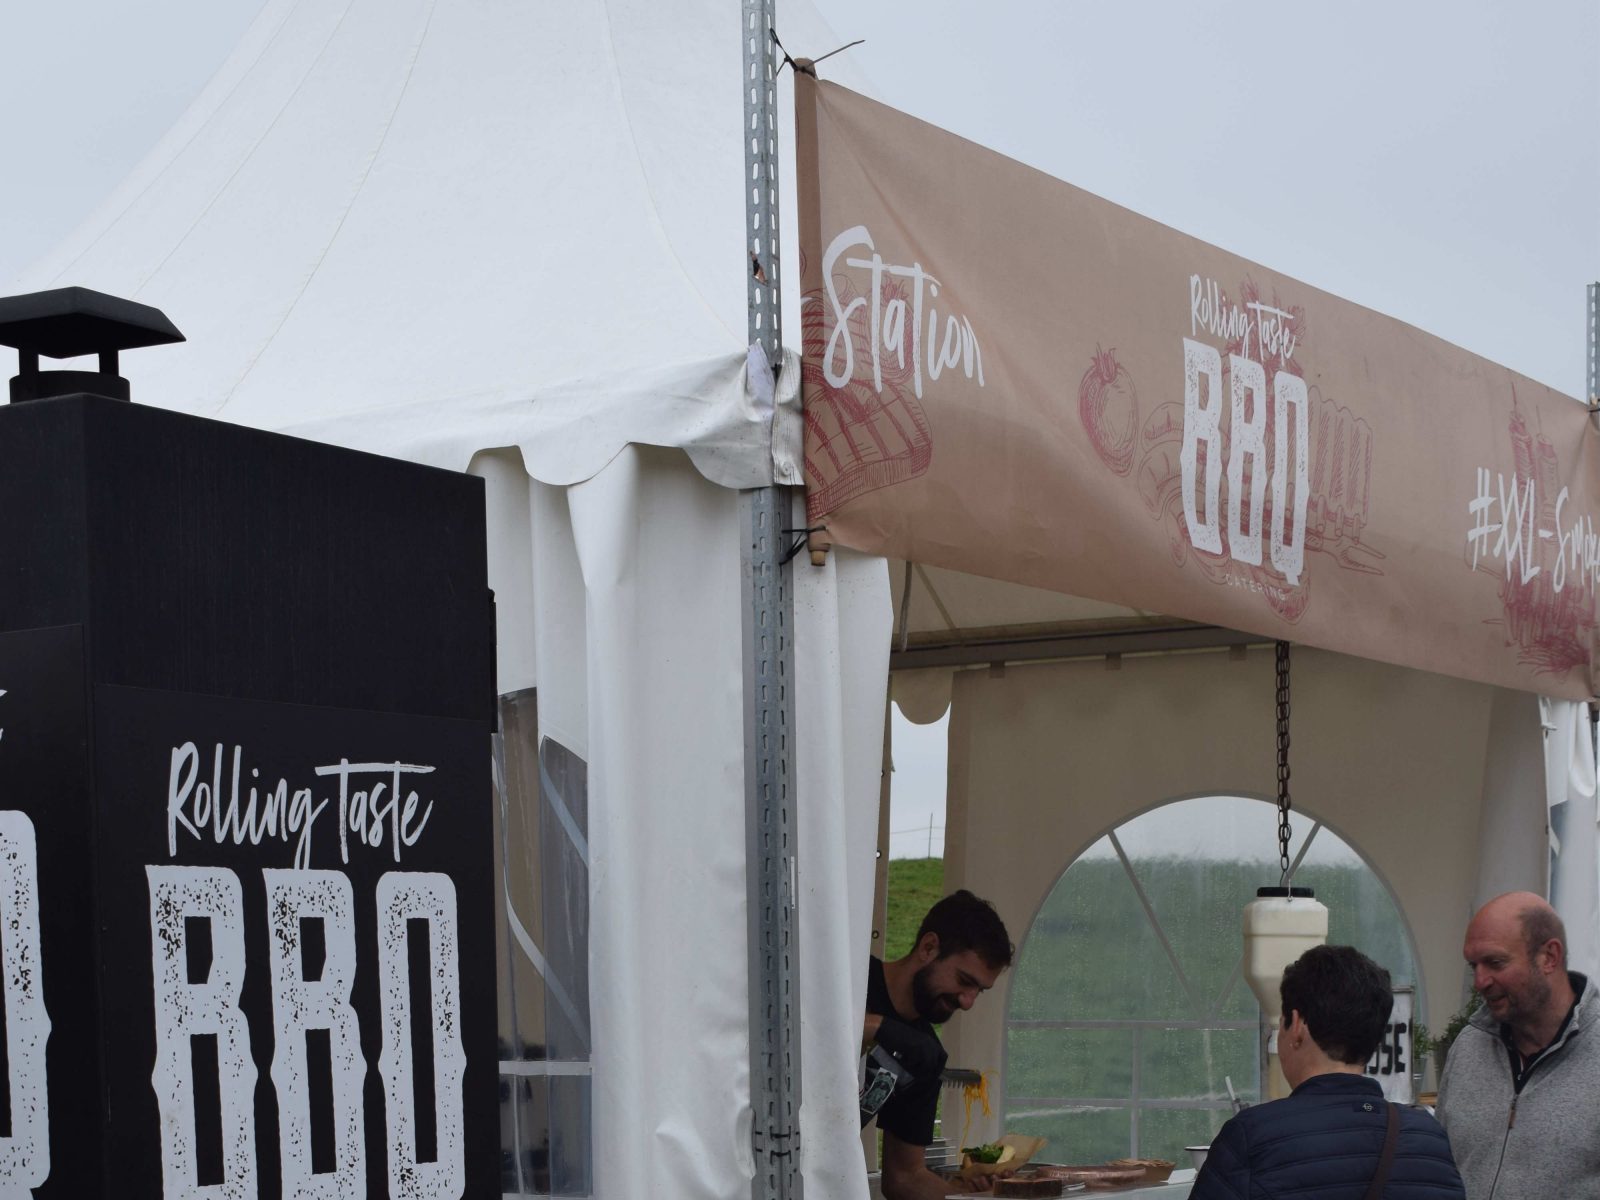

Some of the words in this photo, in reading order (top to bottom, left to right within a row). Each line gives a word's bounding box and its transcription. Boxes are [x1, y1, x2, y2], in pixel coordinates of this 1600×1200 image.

[822, 225, 984, 399] Station
[1190, 273, 1254, 359] Rolling
[1247, 301, 1296, 366] Taste
[1181, 337, 1310, 586] BBQ
[167, 742, 329, 869] Rolling
[315, 758, 436, 864] Taste
